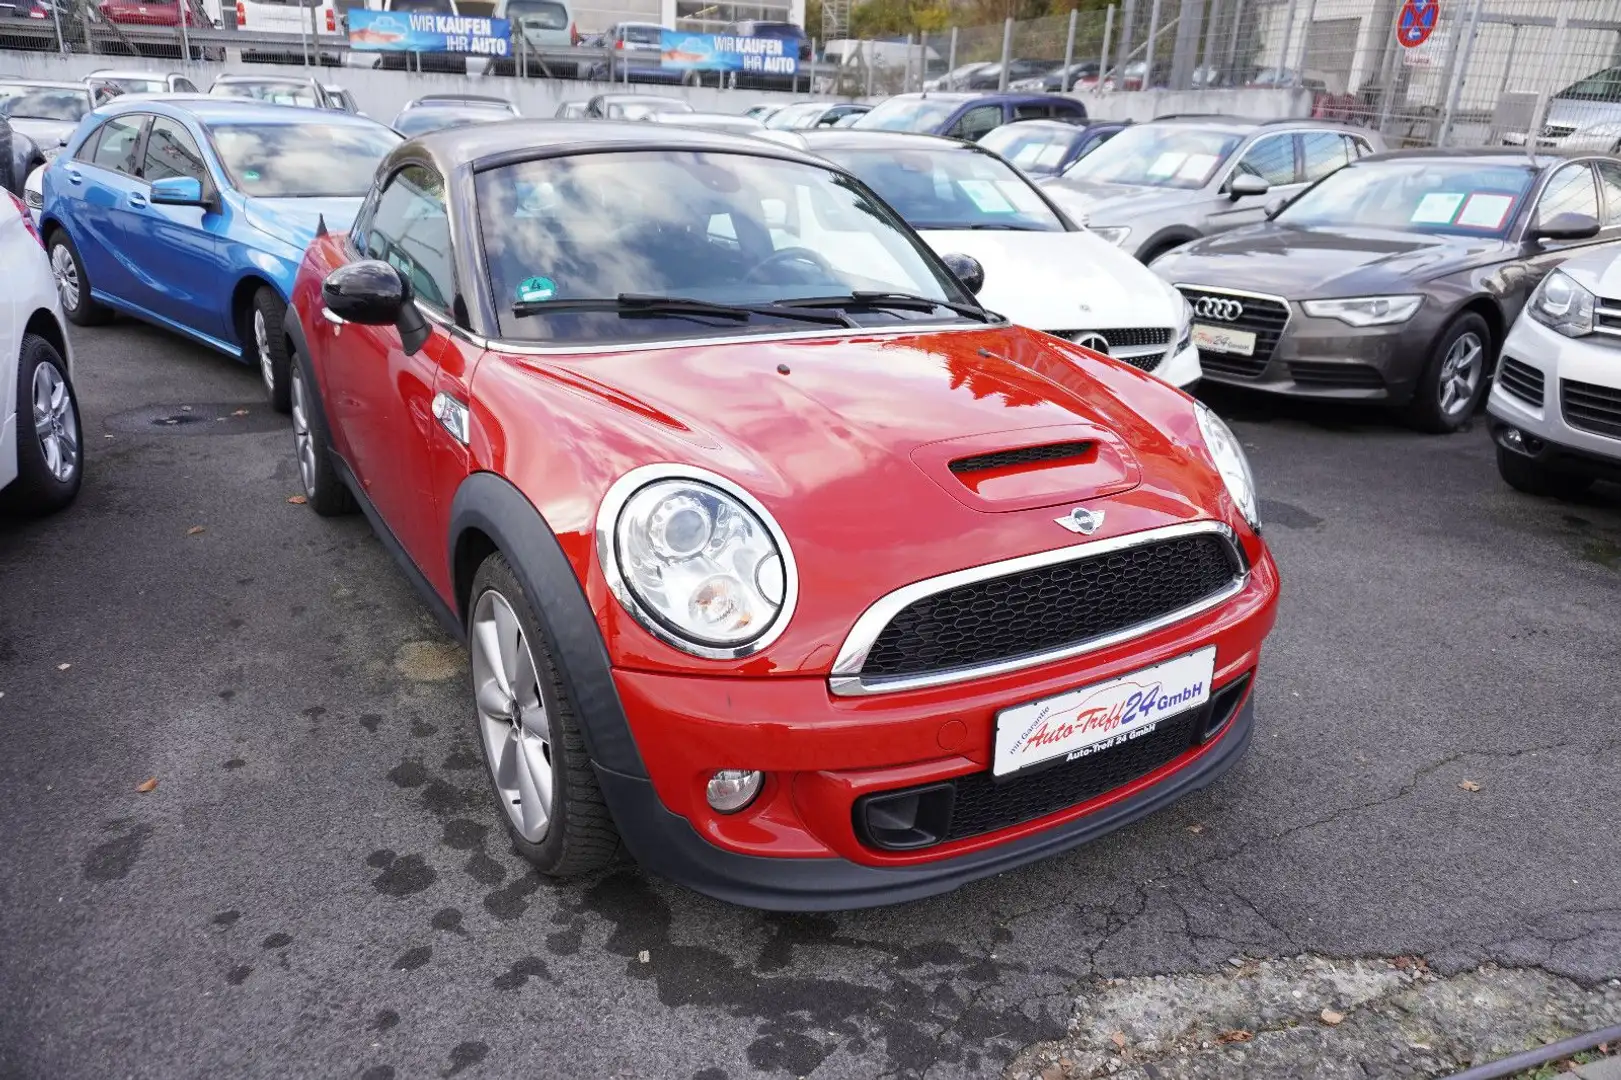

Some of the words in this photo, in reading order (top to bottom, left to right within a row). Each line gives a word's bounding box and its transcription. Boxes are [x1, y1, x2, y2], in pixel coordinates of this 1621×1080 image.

[409, 14, 434, 32] WIR
[436, 16, 491, 36] KAUFEN
[446, 35, 468, 52] IHR
[470, 38, 507, 55] AUTO
[714, 36, 734, 51] WIR
[735, 37, 783, 56] KAUFEN
[744, 55, 762, 70] IHR
[763, 57, 795, 74] AUTO
[1157, 681, 1203, 711] GmbH
[1021, 706, 1050, 740] Garantie
[1066, 738, 1115, 762] Auto-Treff
[1115, 734, 1127, 745] 24
[1128, 723, 1156, 740] GmbH
